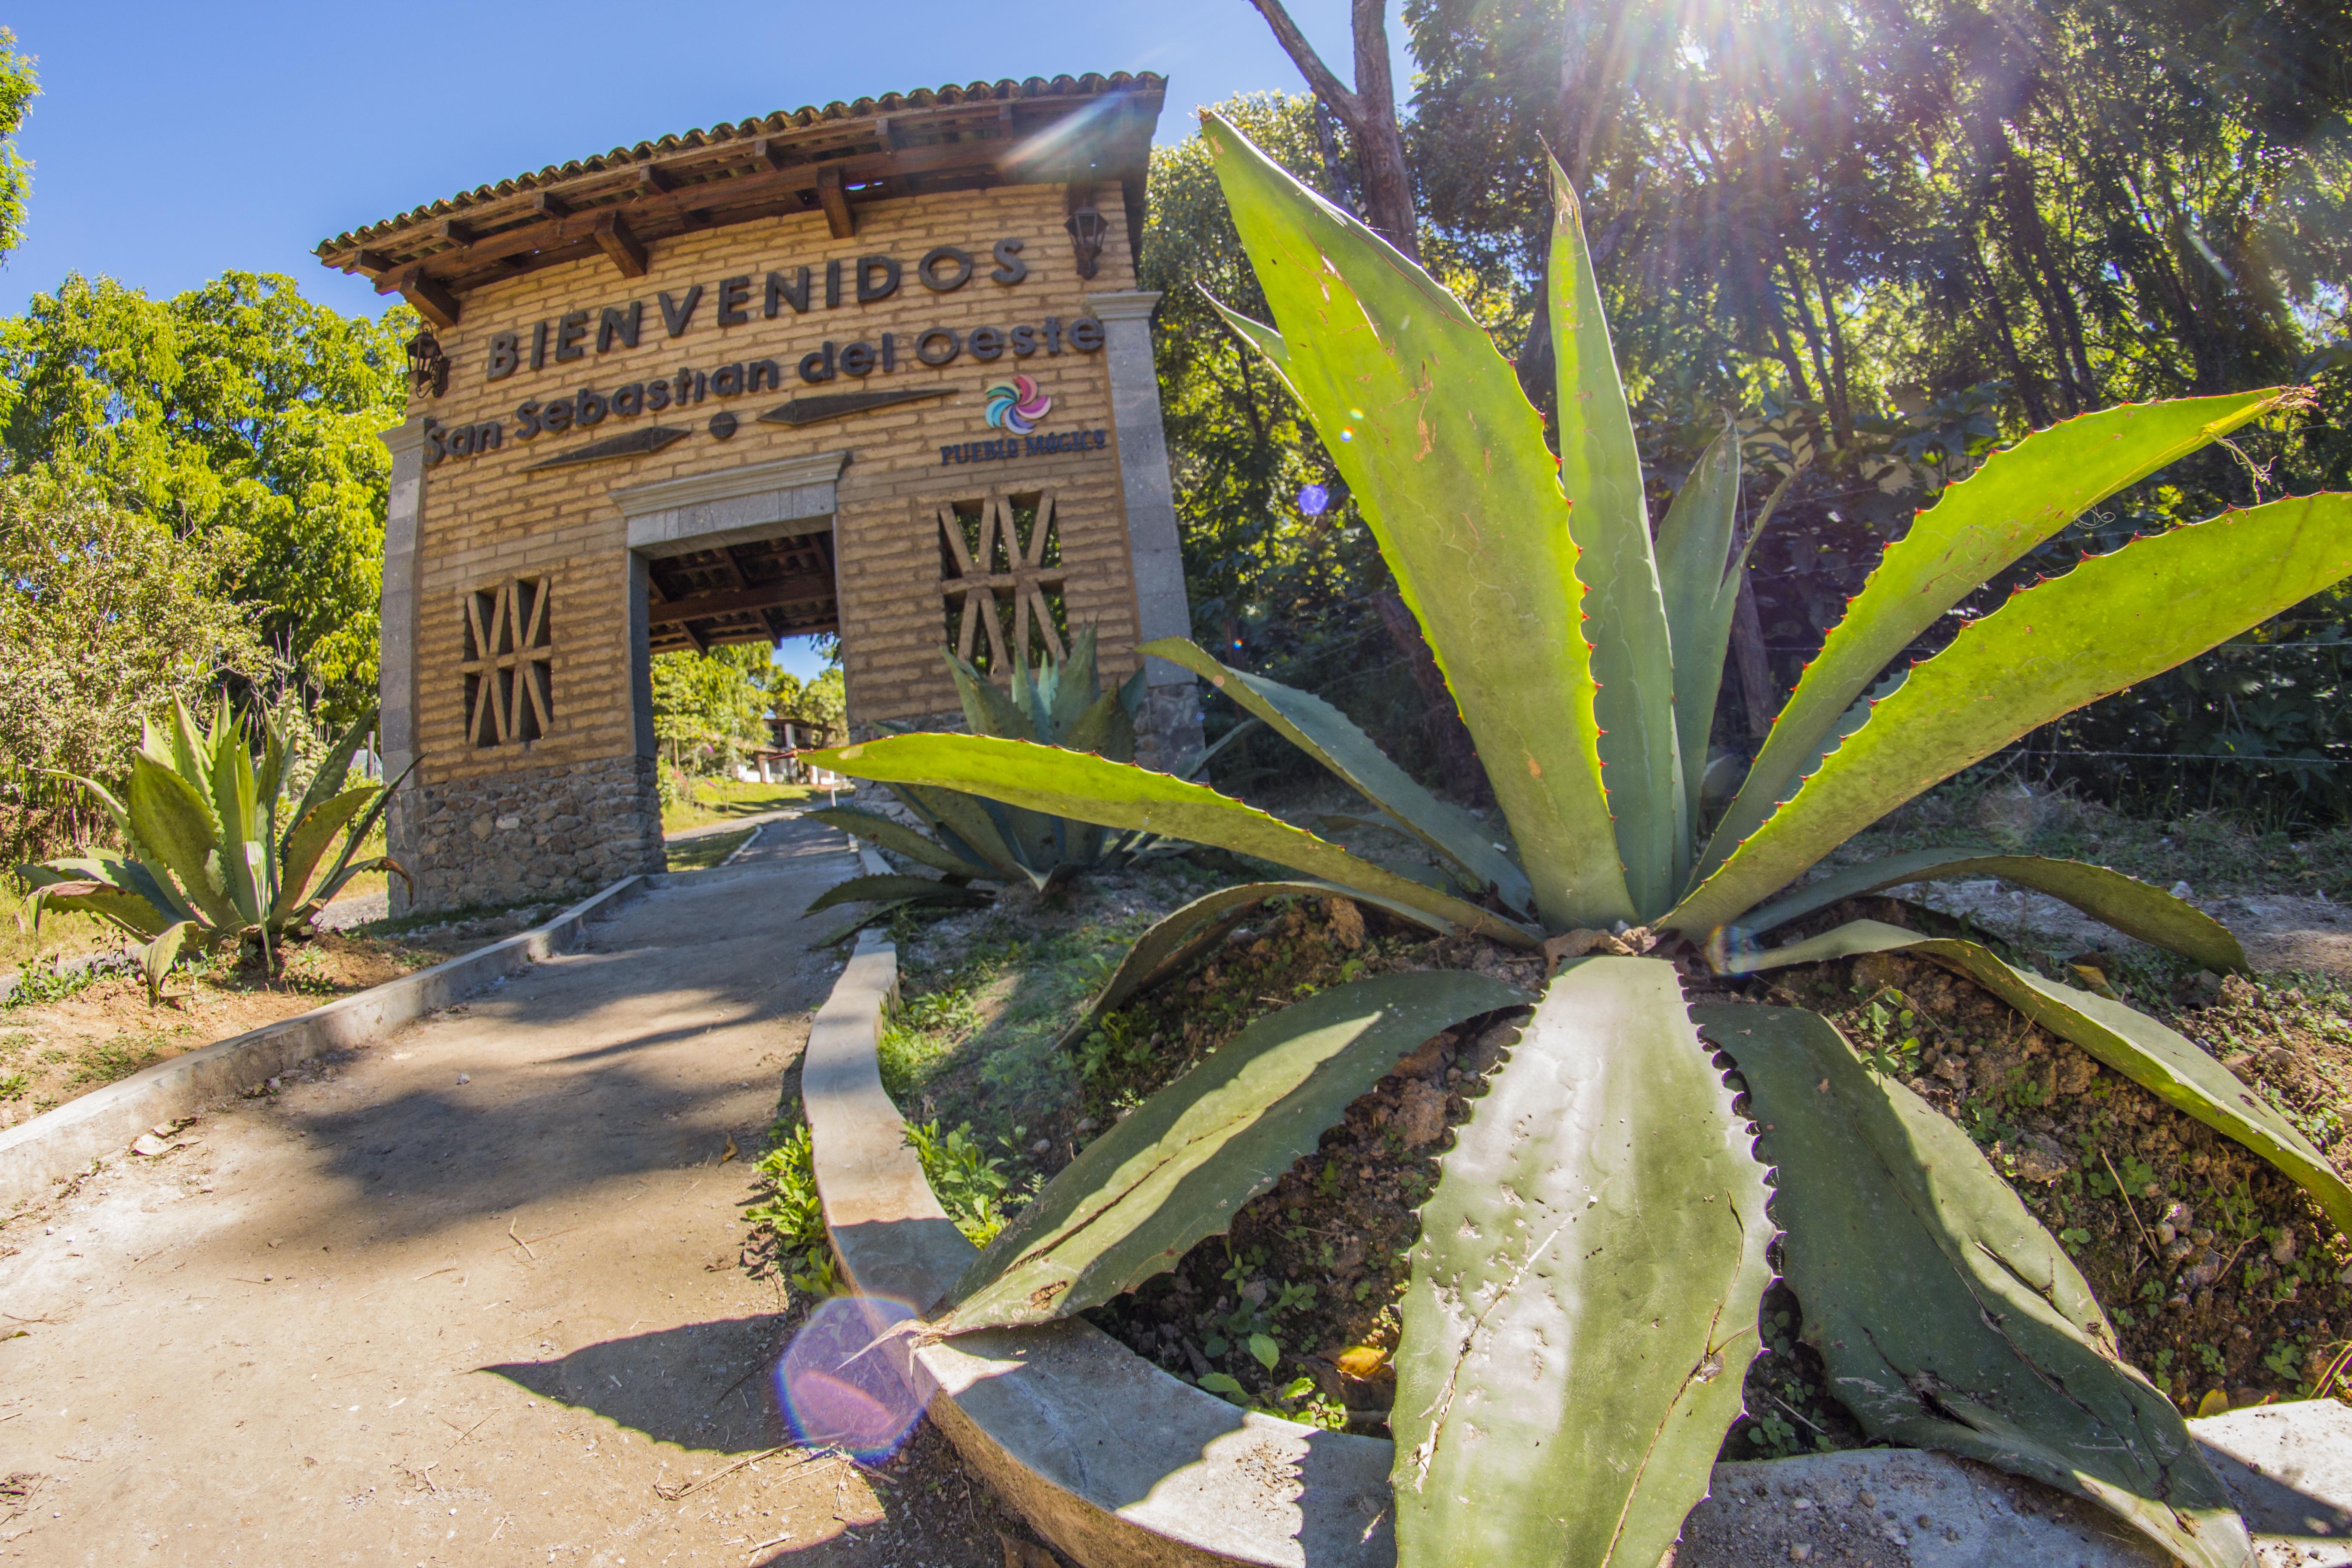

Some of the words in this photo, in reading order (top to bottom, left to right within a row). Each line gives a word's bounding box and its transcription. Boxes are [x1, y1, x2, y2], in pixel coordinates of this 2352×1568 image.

[487, 237, 1027, 381] BIENVENIDOS
[423, 421, 501, 467] San
[515, 359, 778, 441] Sebastian
[799, 332, 894, 383] del
[915, 315, 1105, 365] Oeste
[940, 438, 1018, 466] PUEBLO
